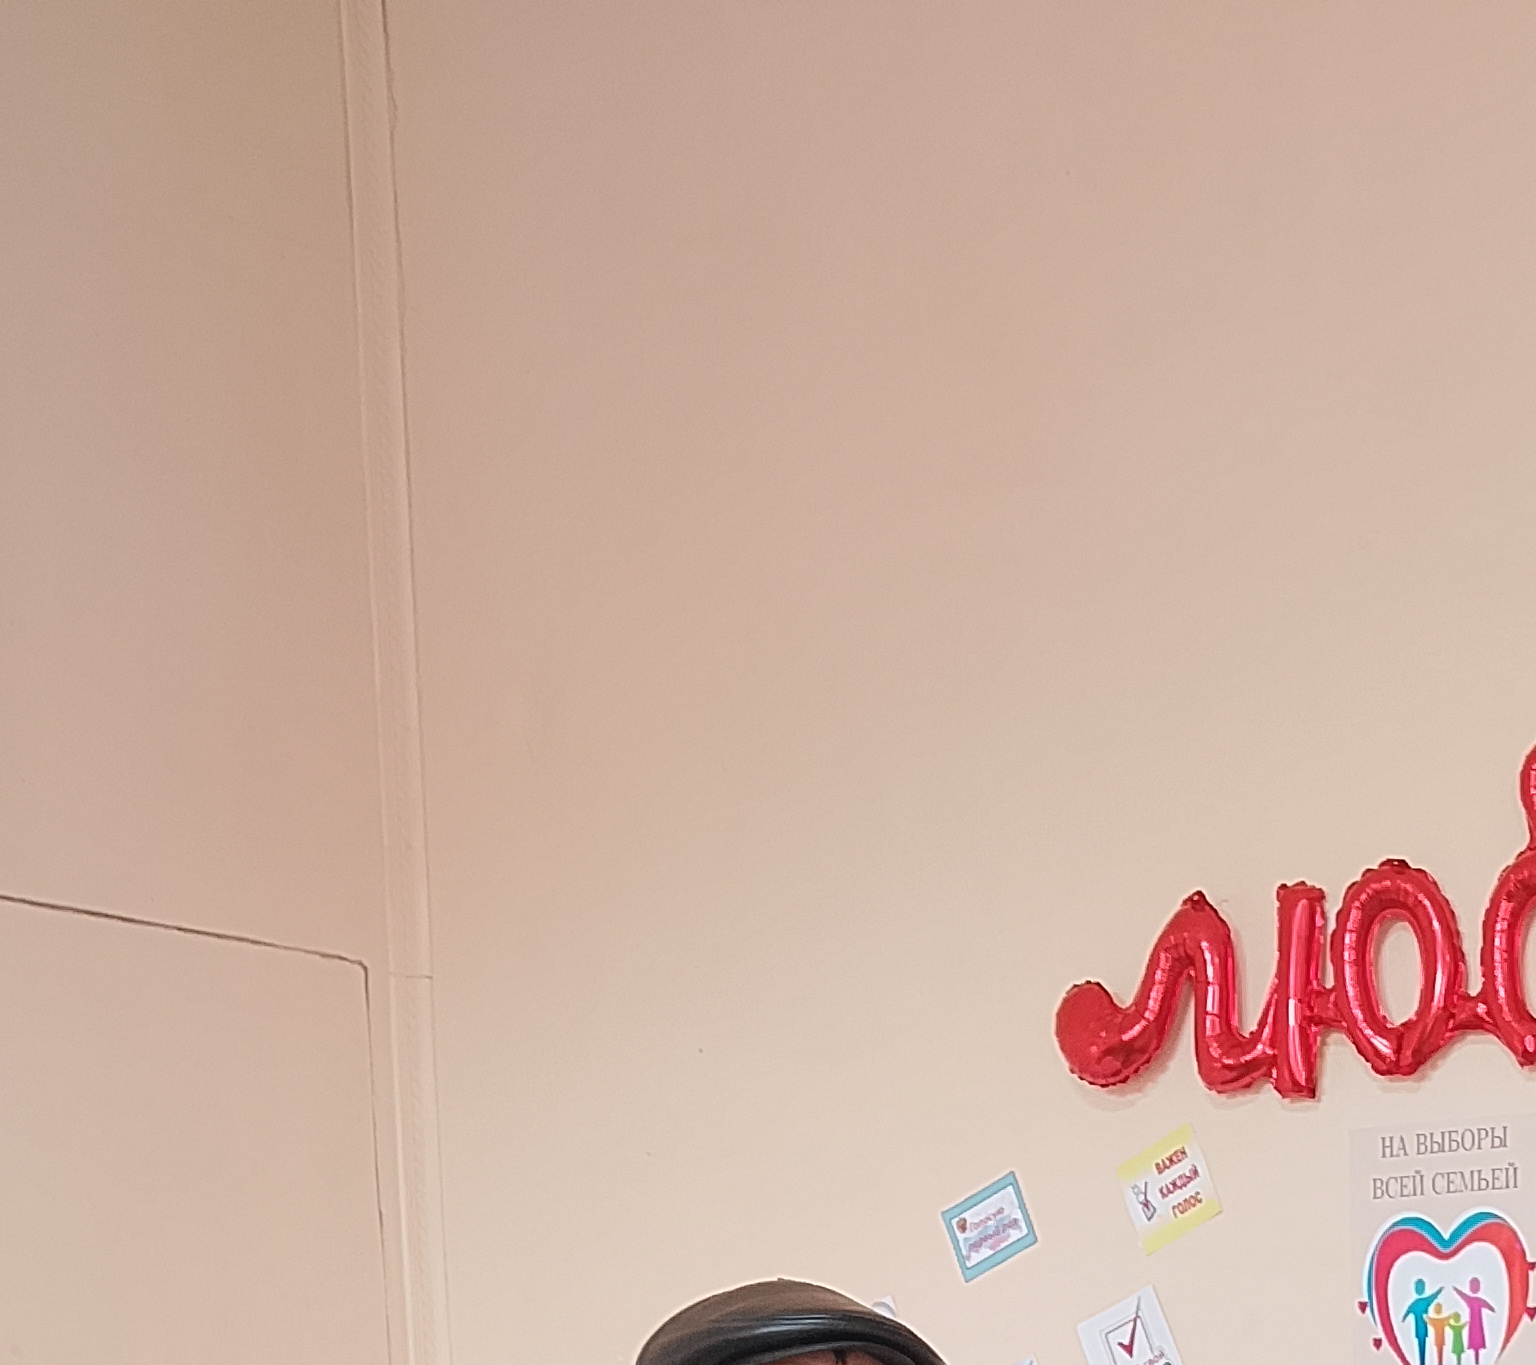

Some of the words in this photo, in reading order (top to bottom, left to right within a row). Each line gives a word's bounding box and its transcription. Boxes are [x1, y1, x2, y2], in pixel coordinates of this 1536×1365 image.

[1380, 1134, 1409, 1158] НА
[1415, 1126, 1508, 1156] ВЫБОРЫ
[1155, 1146, 1188, 1175] ВАЖЕН
[1158, 1163, 1200, 1199] КАЖДЫЙ
[1372, 1169, 1425, 1200] ВСЕЙ
[1431, 1162, 1519, 1195] СЕМЬЕЙ
[1172, 1191, 1203, 1218] ГОЛОС
